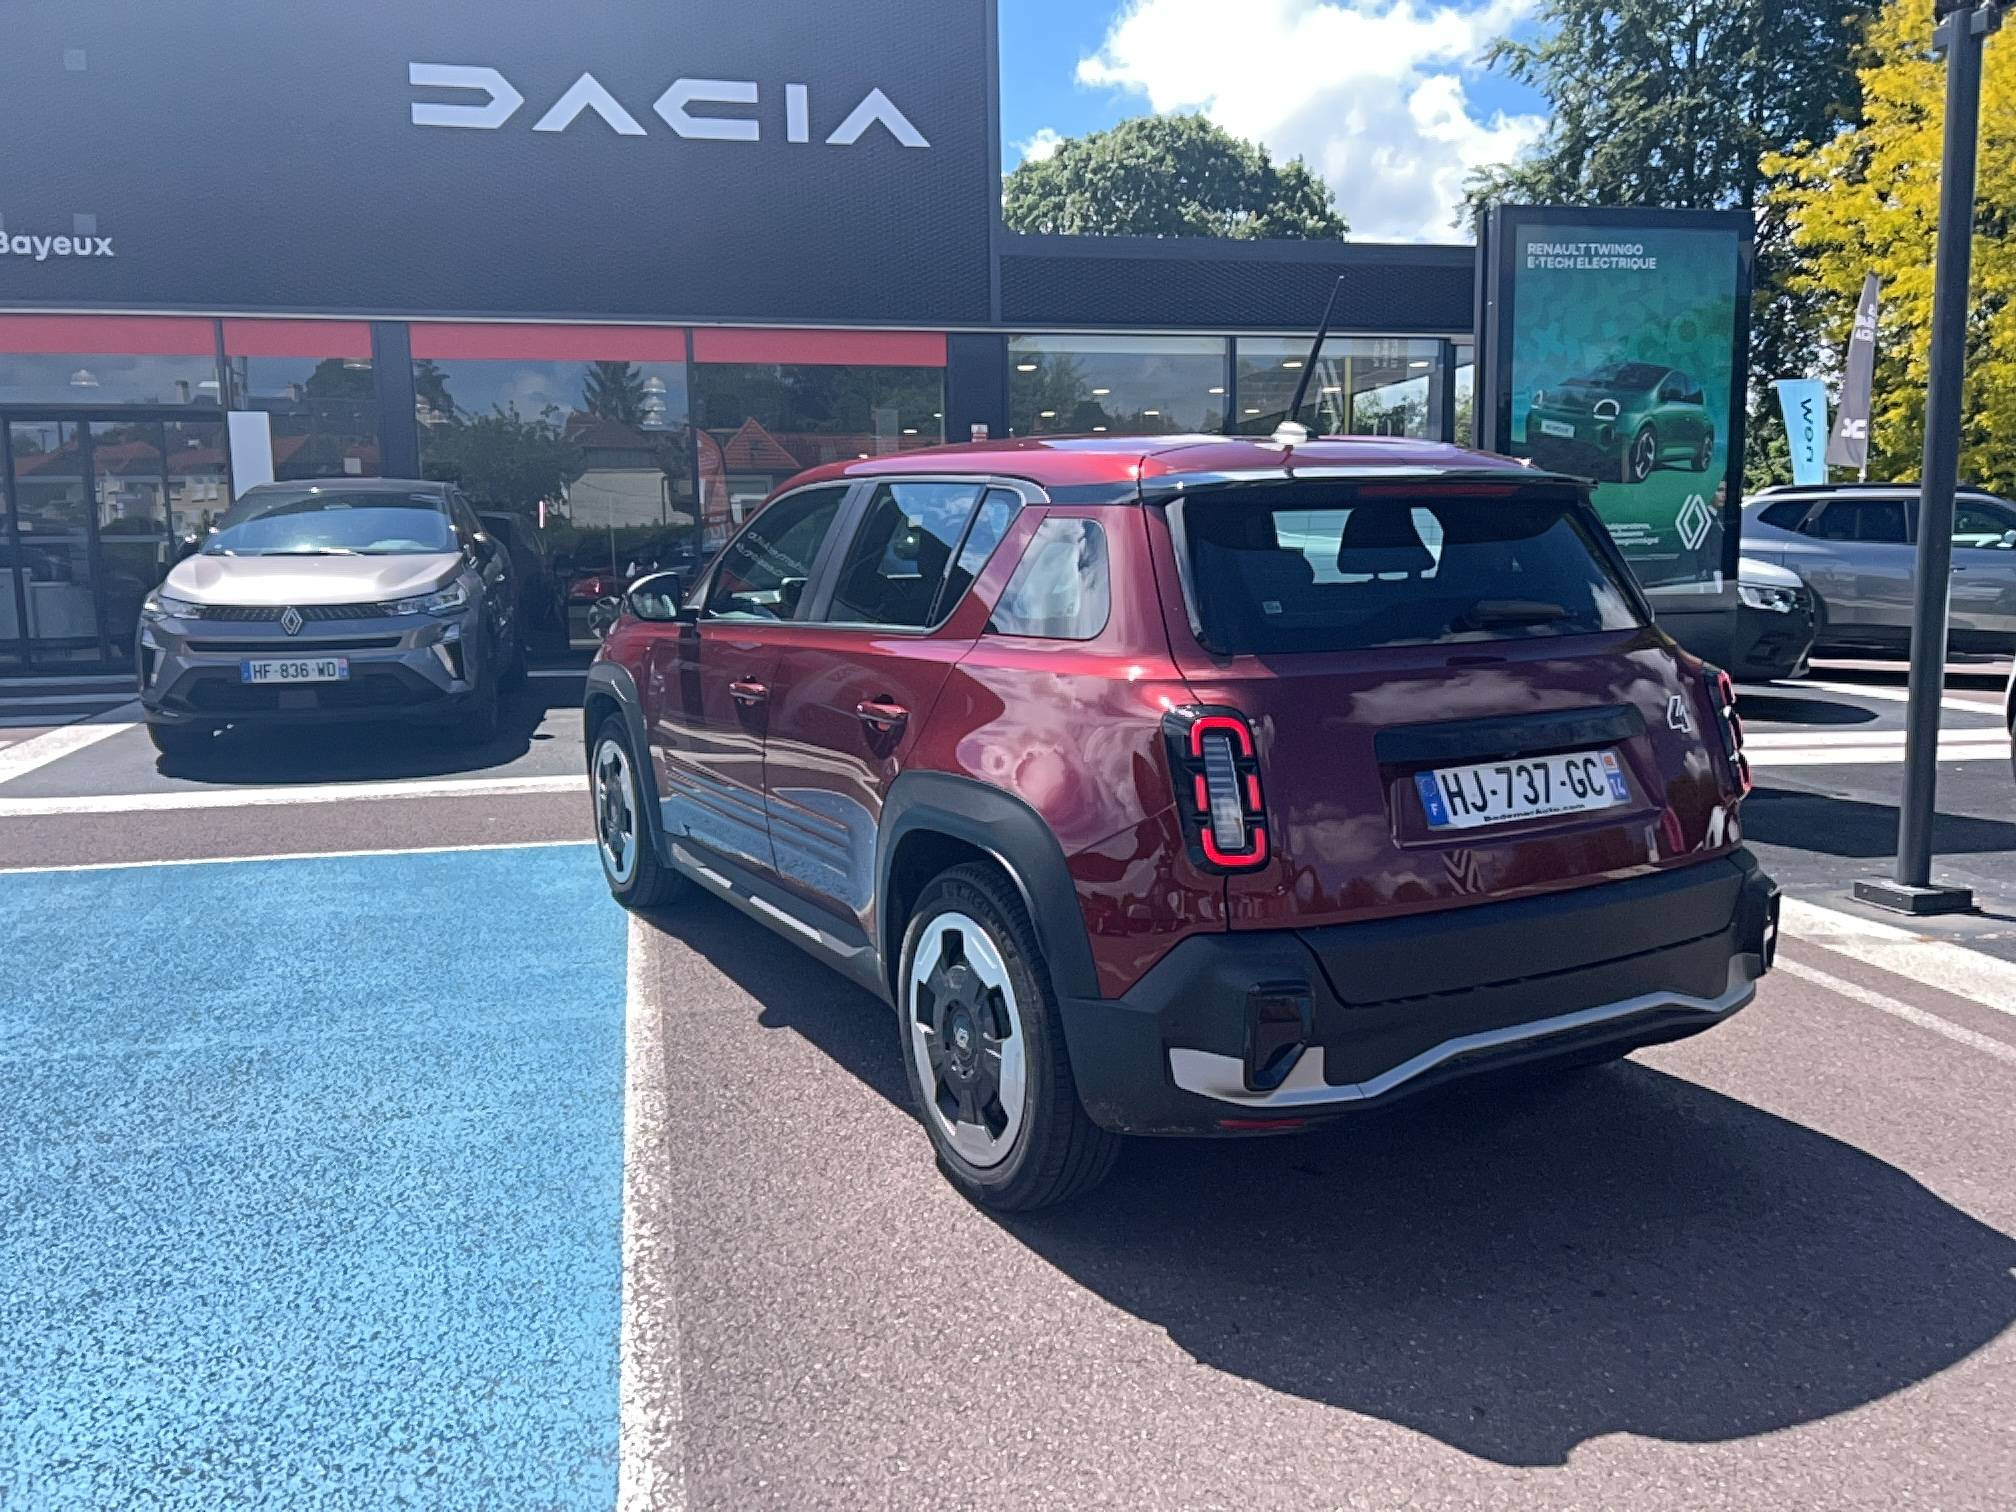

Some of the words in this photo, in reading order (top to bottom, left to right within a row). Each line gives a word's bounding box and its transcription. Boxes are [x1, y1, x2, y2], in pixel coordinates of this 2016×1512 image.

[408, 61, 931, 148] DACIA
[0, 230, 115, 262] Bayeux
[1527, 242, 1587, 255] RENAULT
[1589, 243, 1644, 256] TWINGO
[1667, 694, 1692, 734] 4
[1441, 757, 1605, 817] HJ-737-GC
[1430, 803, 1438, 816] F
